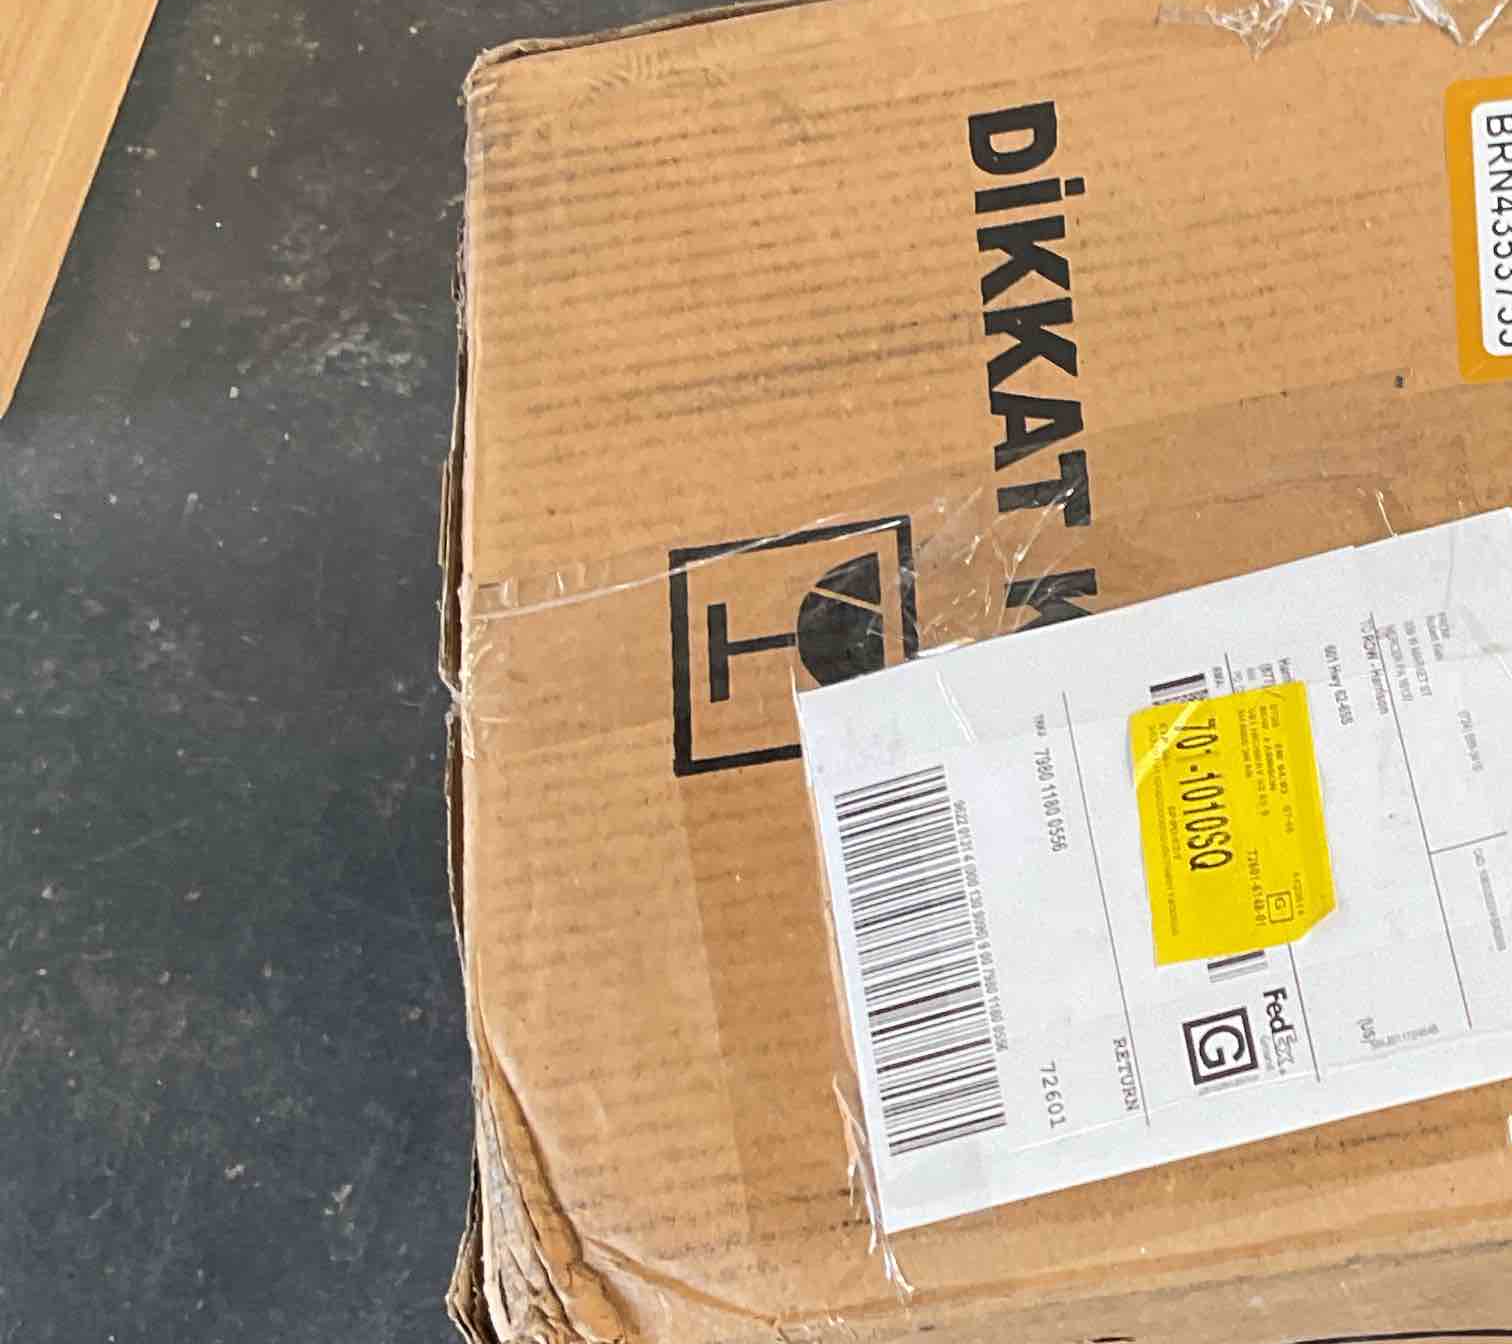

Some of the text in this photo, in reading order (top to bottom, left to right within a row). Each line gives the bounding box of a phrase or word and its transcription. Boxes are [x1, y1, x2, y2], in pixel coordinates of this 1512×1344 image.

[967, 100, 1091, 525] DİKKAT
[1033, 747, 1055, 781] 7980
[1040, 782, 1061, 818] 1180
[1171, 716, 1234, 872] 701-1010SQ
[1046, 818, 1068, 852] 0556
[1198, 1025, 1245, 1067] G
[1040, 1062, 1065, 1129] 72601
[1113, 1037, 1136, 1111] RETURN
